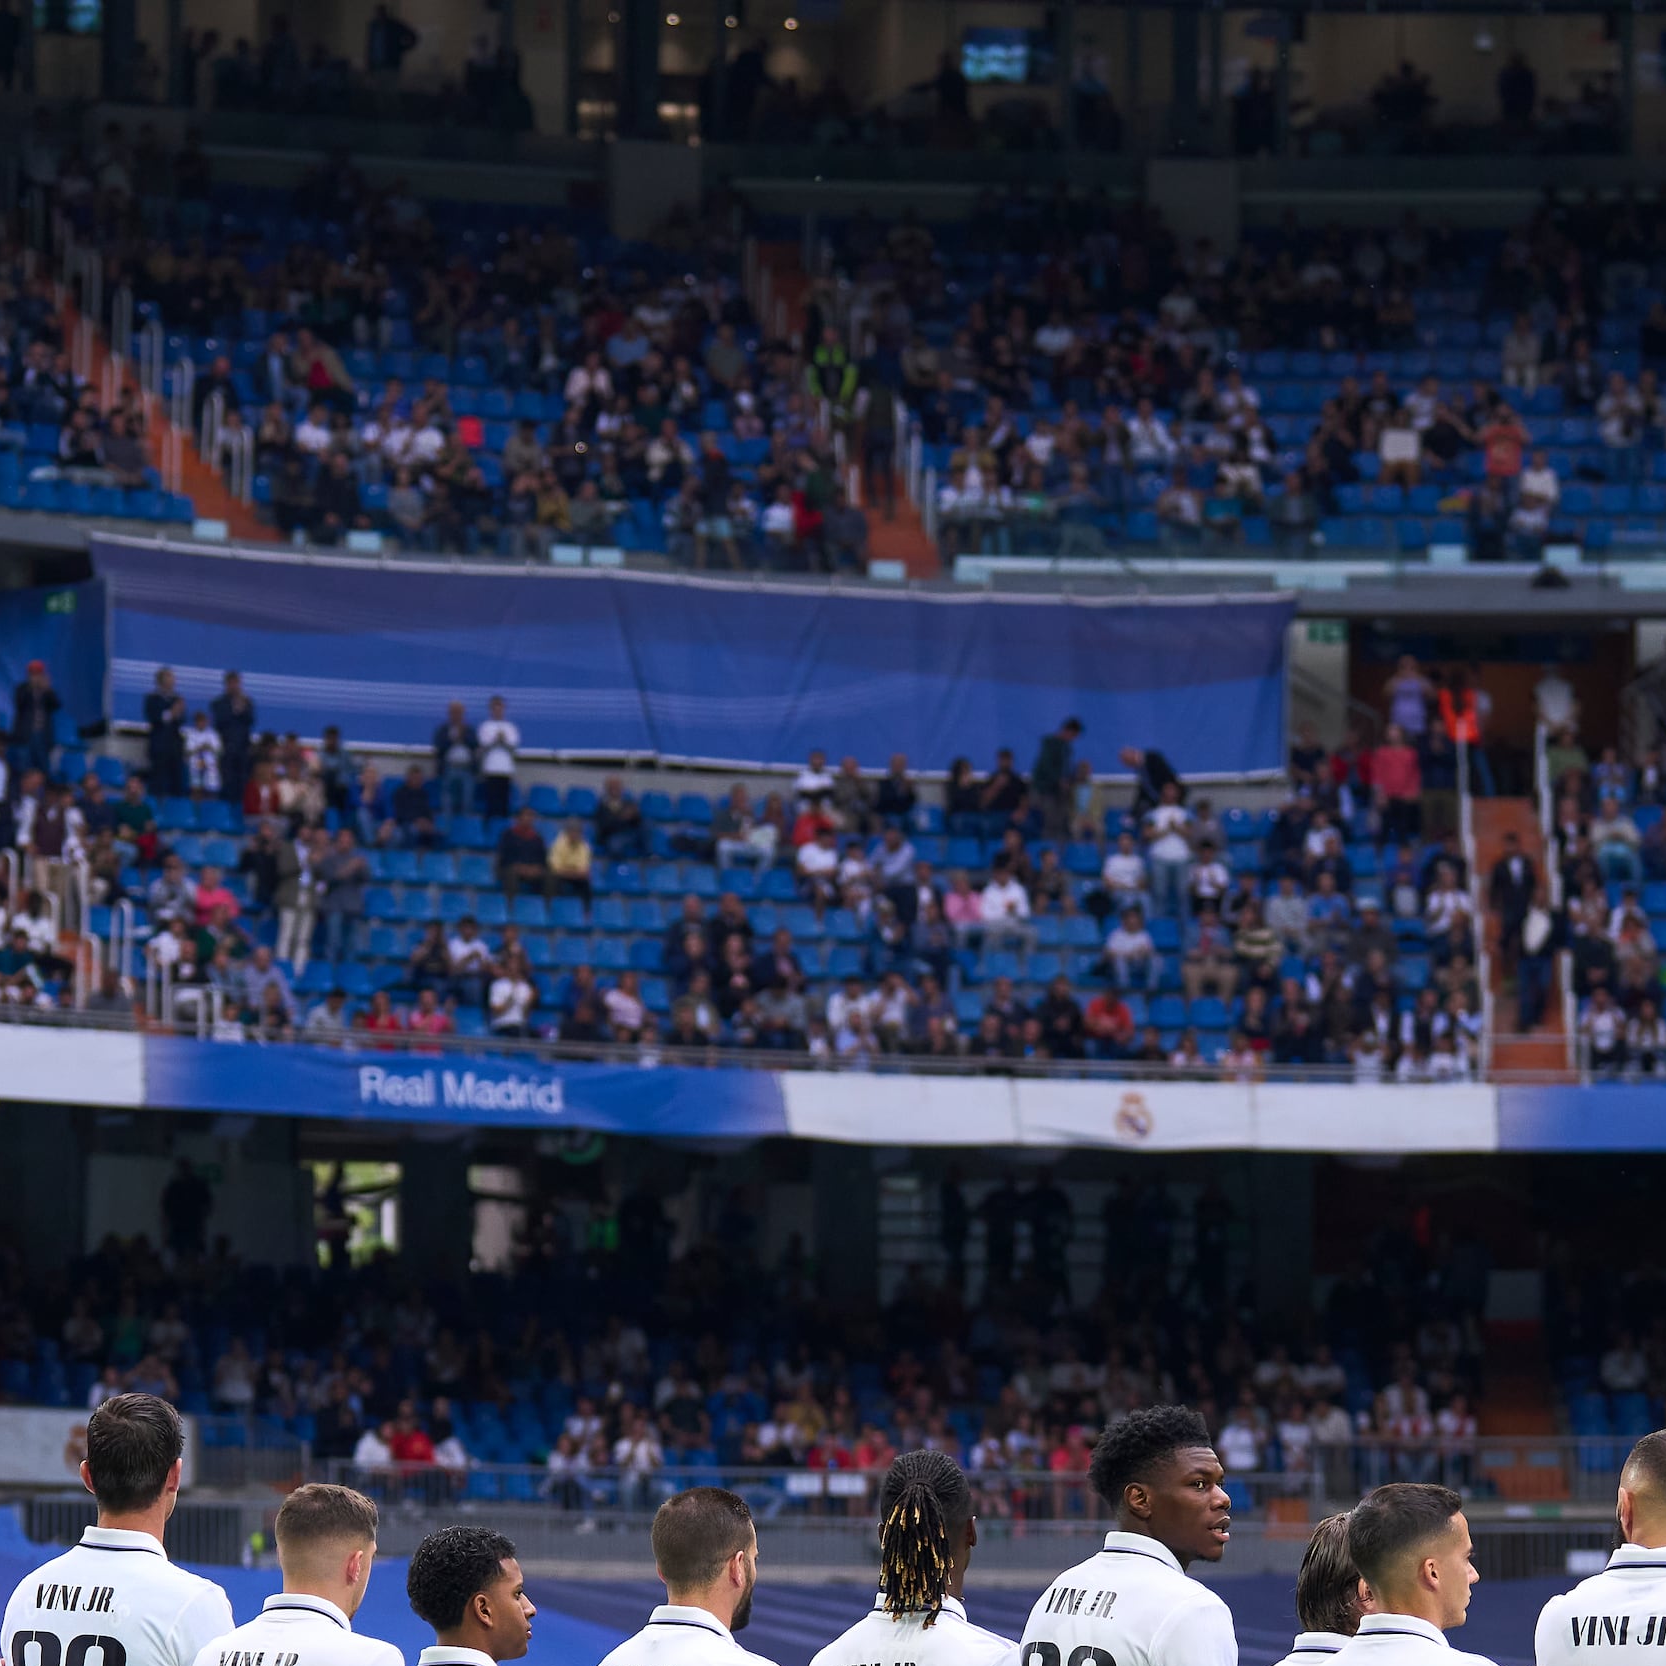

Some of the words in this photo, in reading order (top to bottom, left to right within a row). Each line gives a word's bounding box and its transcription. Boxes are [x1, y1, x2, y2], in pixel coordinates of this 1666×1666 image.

[359, 1066, 440, 1108] Real
[446, 1070, 565, 1115] Madrid
[37, 1583, 81, 1611] VINI
[82, 1586, 114, 1613] JR.
[1045, 1587, 1084, 1615] VINI
[1085, 1589, 1114, 1620] JR.
[1572, 1616, 1629, 1647] VINI
